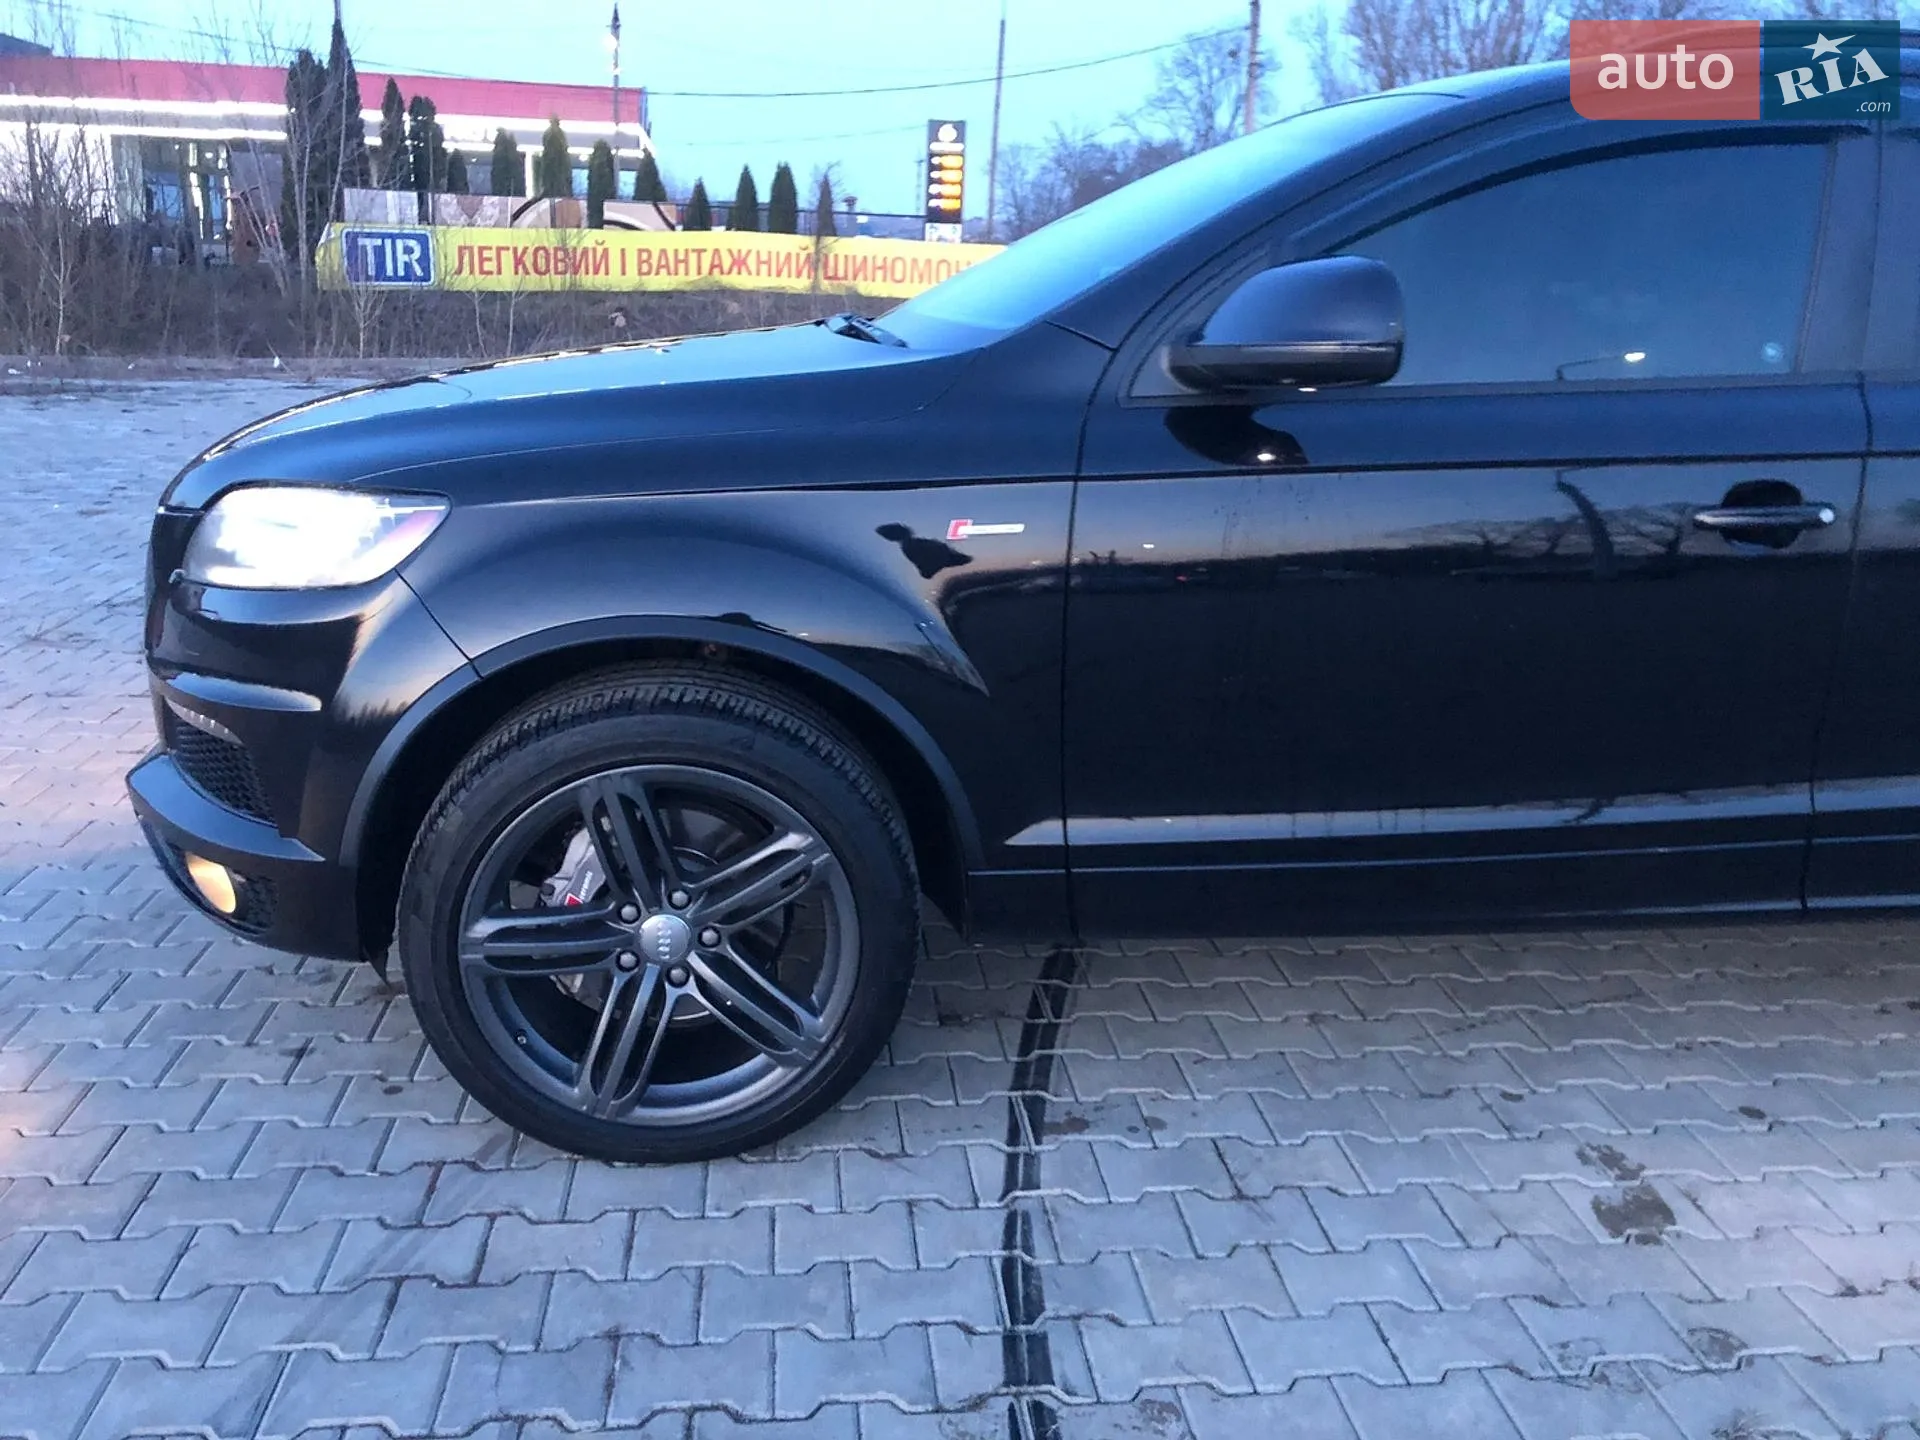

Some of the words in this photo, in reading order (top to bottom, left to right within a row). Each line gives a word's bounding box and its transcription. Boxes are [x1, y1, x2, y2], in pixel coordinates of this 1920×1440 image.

[356, 237, 425, 277] TIR
[455, 240, 611, 276] ЛЕГКОВИЙ
[636, 245, 815, 280] ВАНТАЖНИЙ
